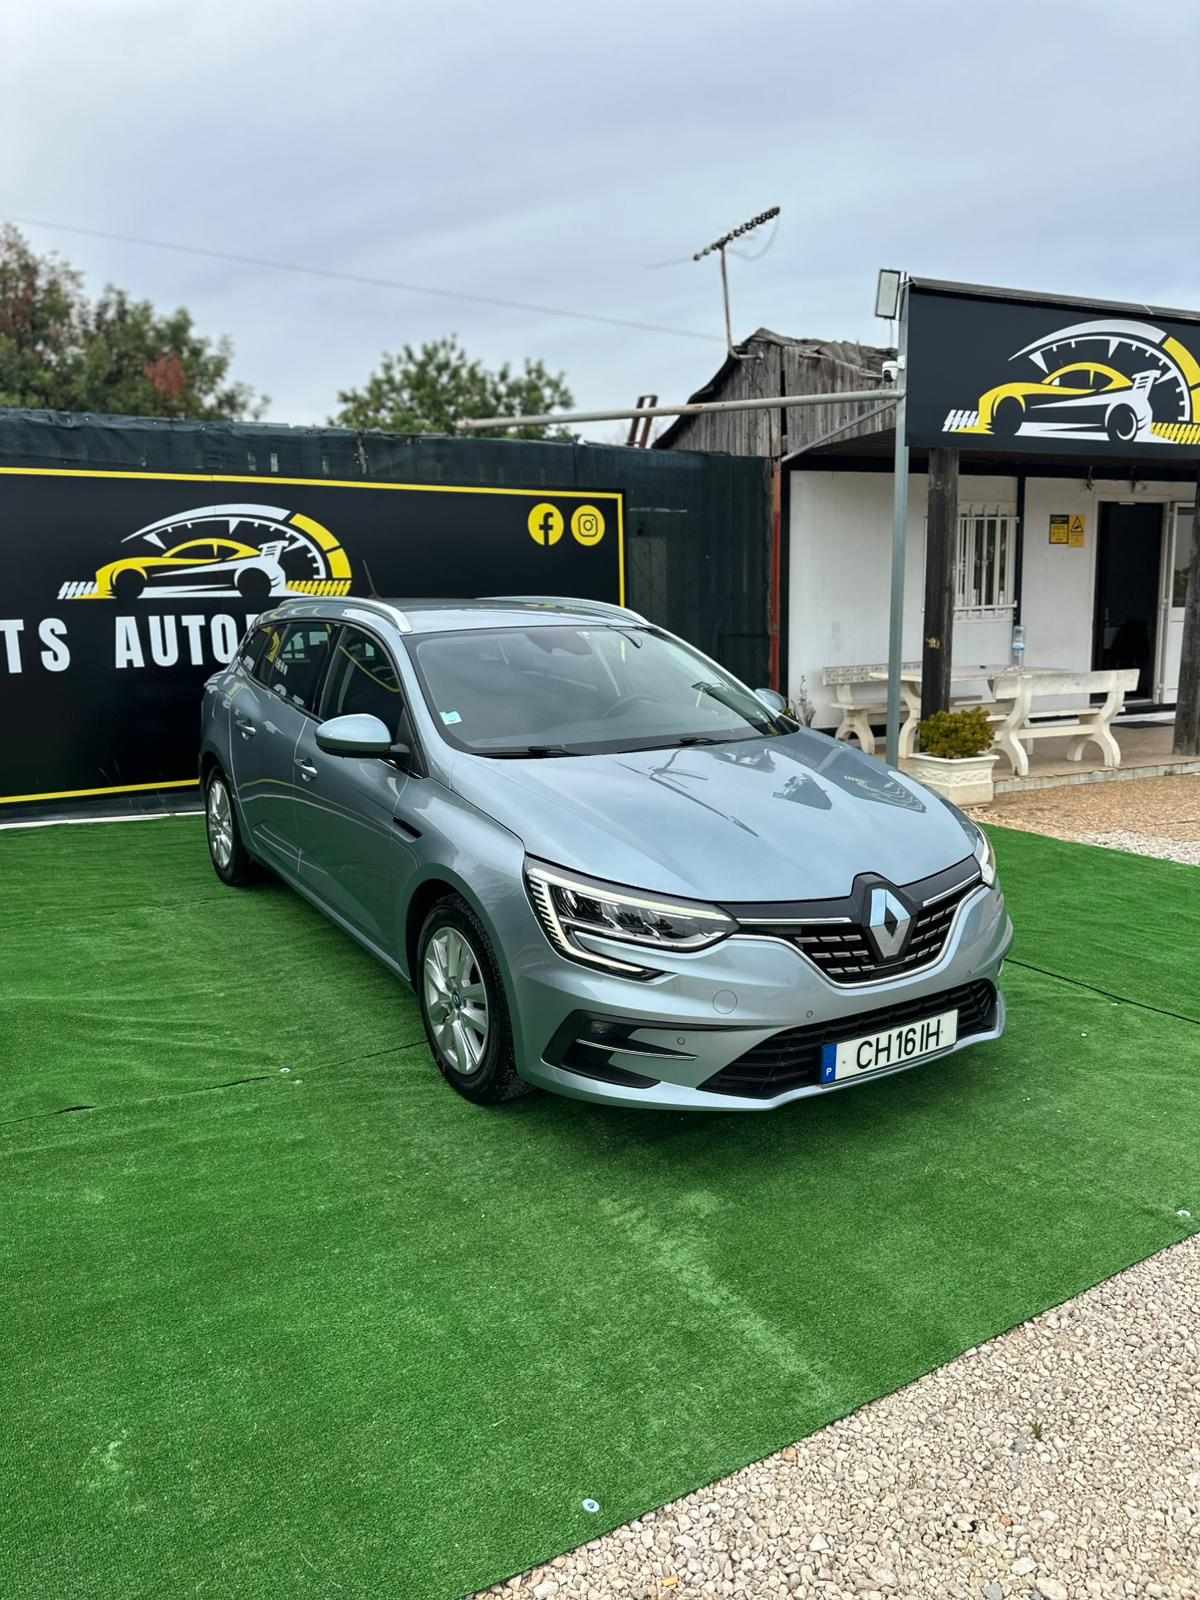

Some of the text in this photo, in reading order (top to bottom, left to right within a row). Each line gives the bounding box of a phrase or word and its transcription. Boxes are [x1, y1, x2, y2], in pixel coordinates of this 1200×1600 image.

[0, 613, 260, 674] TS AUTO
[825, 1067, 833, 1077] P
